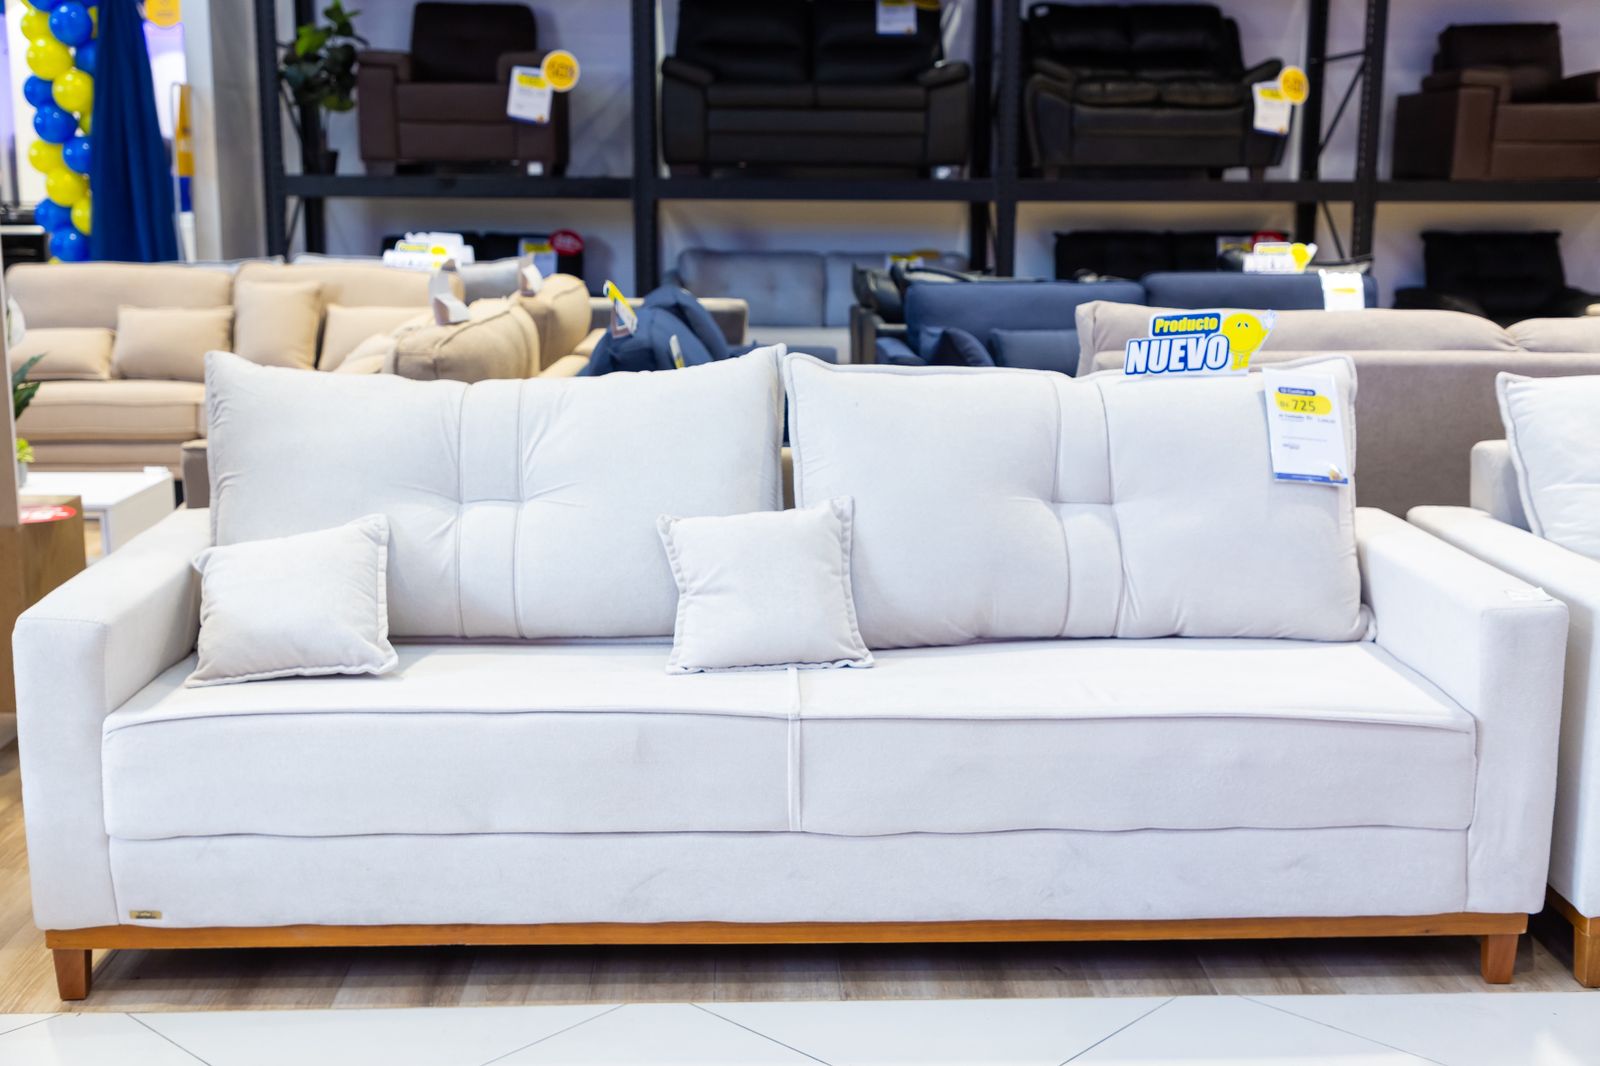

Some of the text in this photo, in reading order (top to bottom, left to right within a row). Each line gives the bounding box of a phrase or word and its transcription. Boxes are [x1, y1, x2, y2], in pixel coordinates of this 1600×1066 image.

[1154, 317, 1218, 333] Producto
[1126, 335, 1229, 374] NUEVO
[1292, 399, 1316, 412] 725
